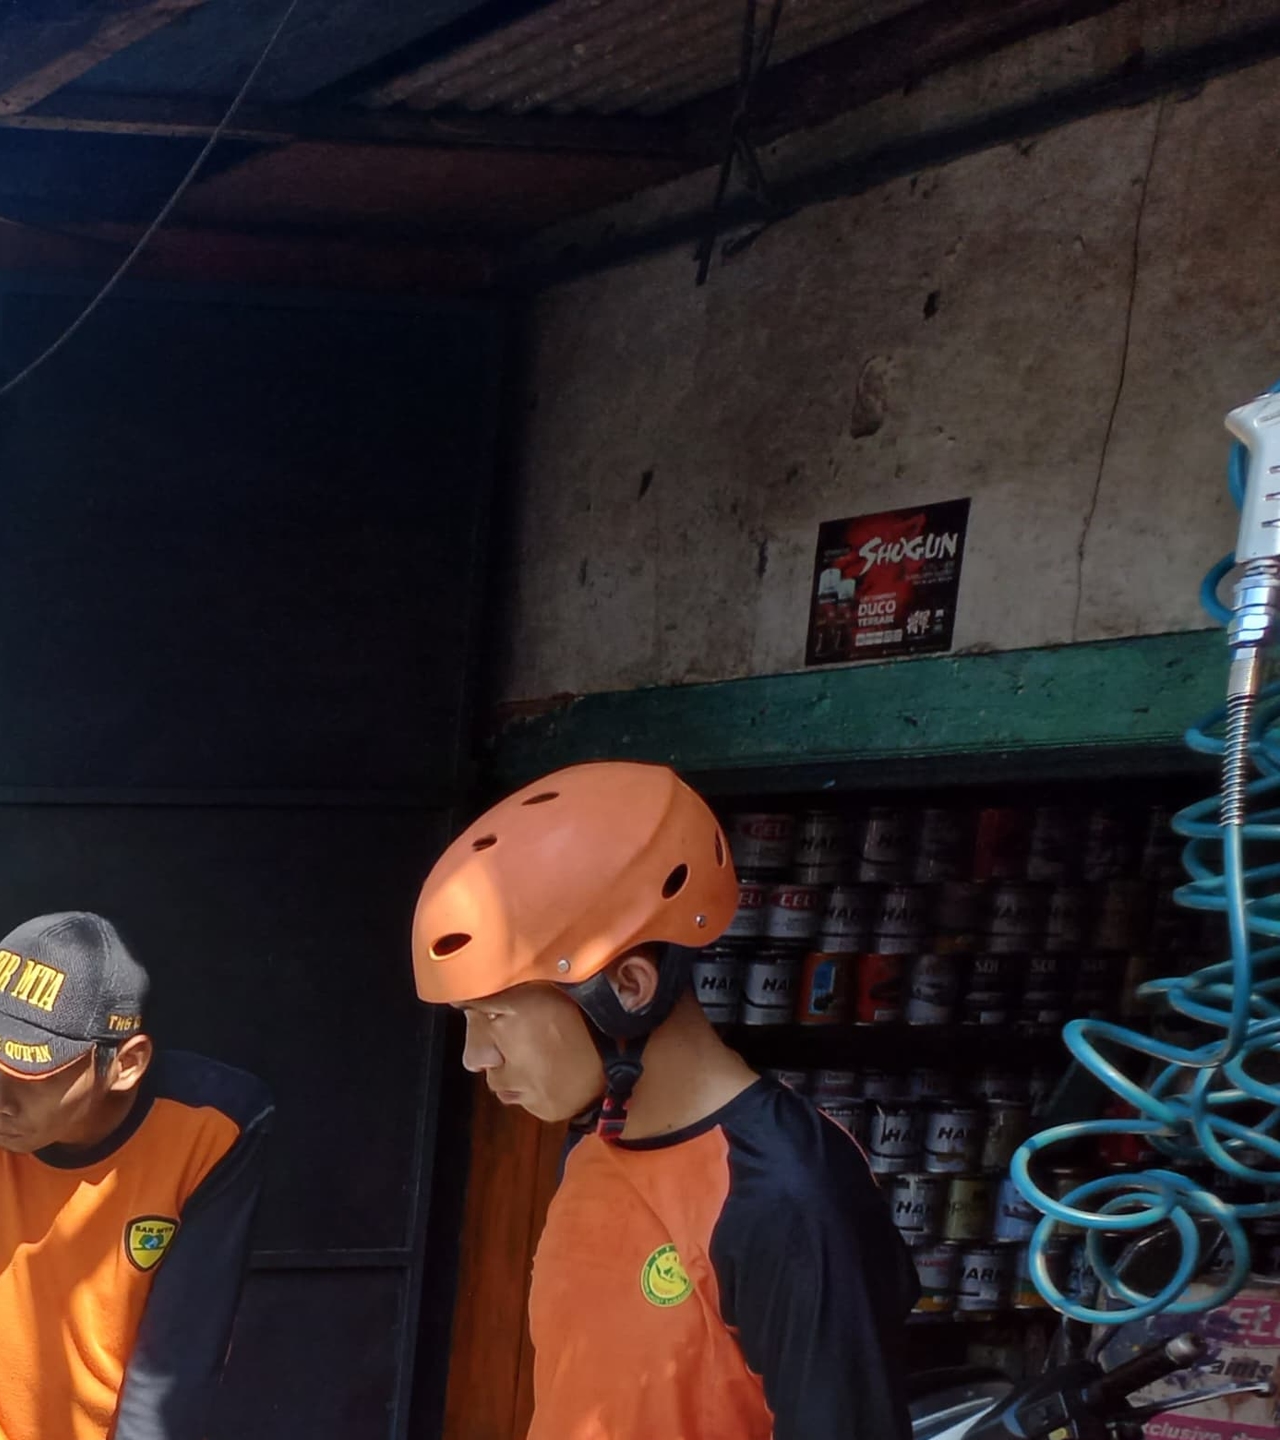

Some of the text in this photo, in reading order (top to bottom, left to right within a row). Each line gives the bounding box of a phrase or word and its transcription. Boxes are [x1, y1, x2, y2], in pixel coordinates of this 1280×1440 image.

[858, 532, 959, 577] SHOGUN
[857, 600, 897, 617] DUCO
[10, 959, 66, 1012] MTA
